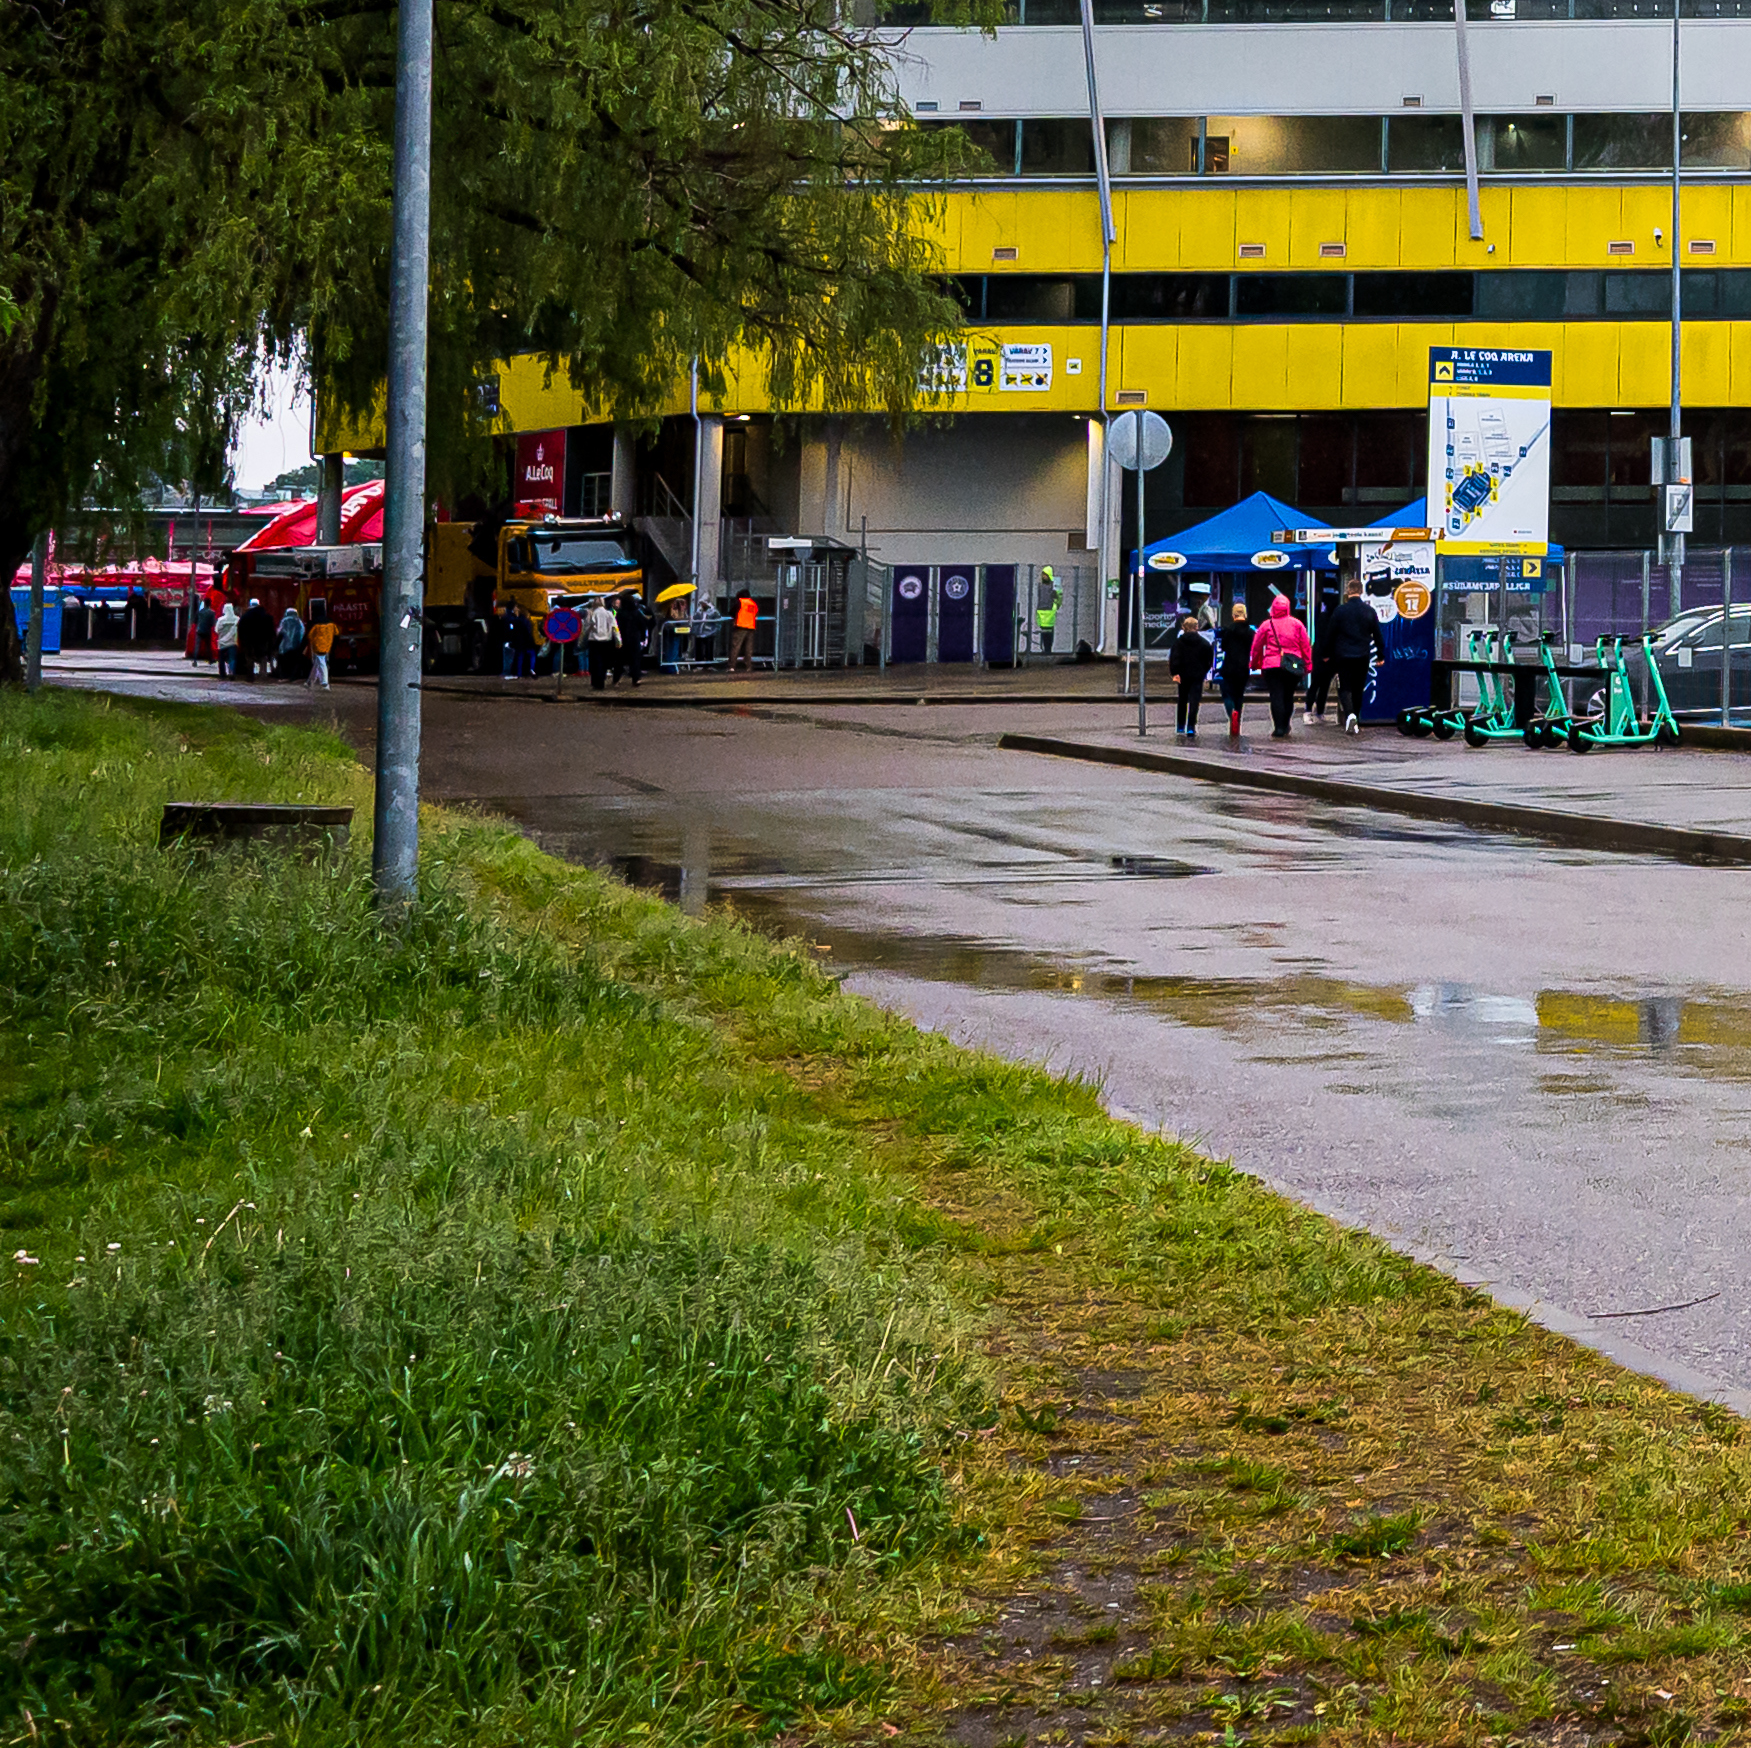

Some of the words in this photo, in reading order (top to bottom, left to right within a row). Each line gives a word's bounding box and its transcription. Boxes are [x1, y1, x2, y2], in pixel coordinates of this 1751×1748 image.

[1464, 351, 1476, 361] LE
[1479, 351, 1499, 362] COQ
[1500, 352, 1534, 363] ARENA
[974, 359, 994, 387] 8
